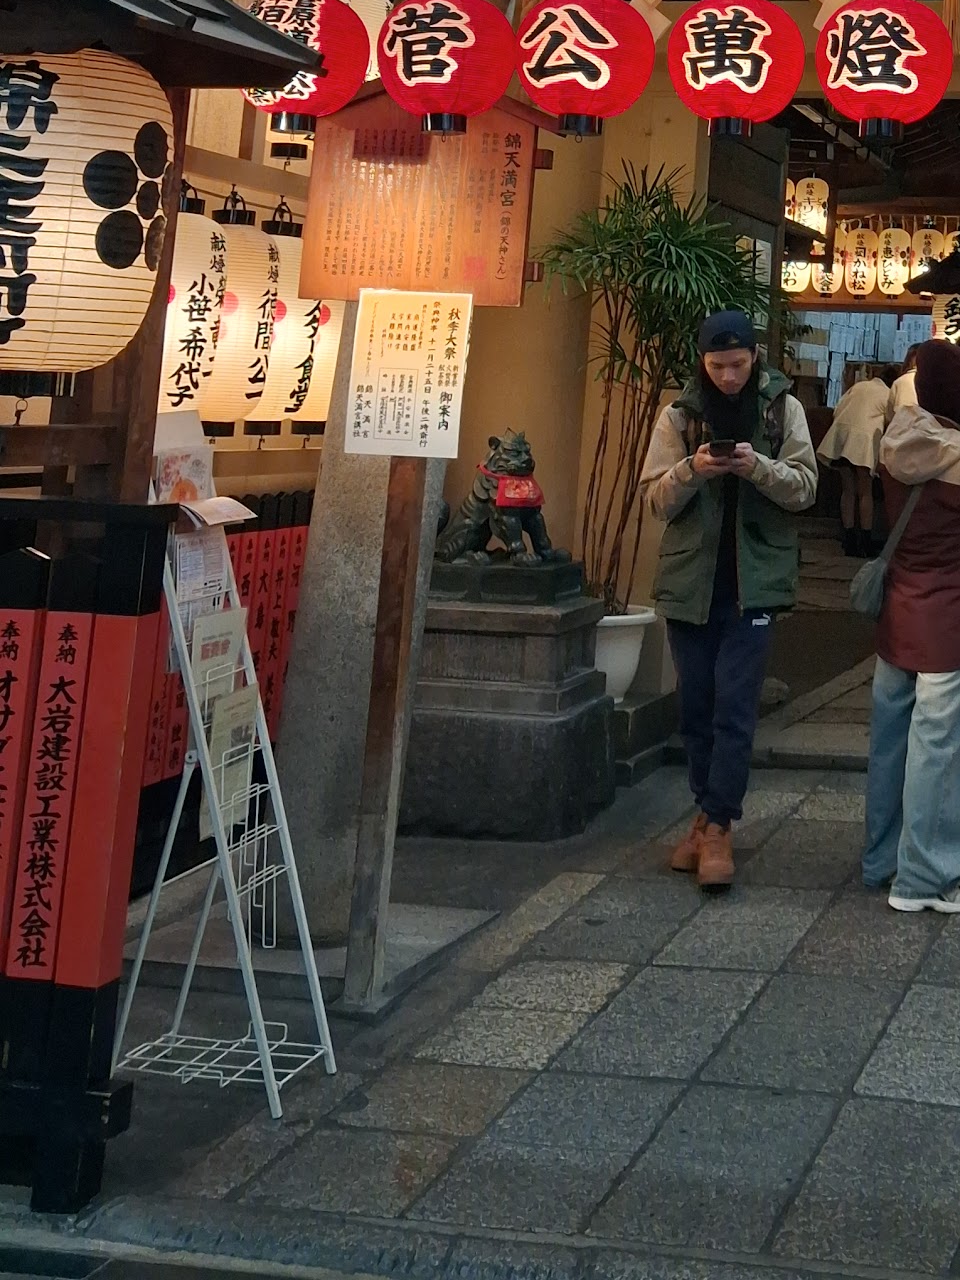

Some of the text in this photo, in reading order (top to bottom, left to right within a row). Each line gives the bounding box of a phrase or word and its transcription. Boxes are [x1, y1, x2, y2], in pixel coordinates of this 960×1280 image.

[388, 2, 472, 84] 菅
[524, 8, 613, 86] 公
[686, 11, 769, 90] 萬
[829, 11, 919, 89] 燈
[500, 132, 522, 207] 錦天満宮
[167, 273, 214, 408] 小笹希代子
[444, 308, 462, 360] 秋季大祭
[437, 392, 453, 431] 御案内
[55, 623, 79, 665] 奉納
[13, 674, 77, 969] 大岩建設工業株式会社
